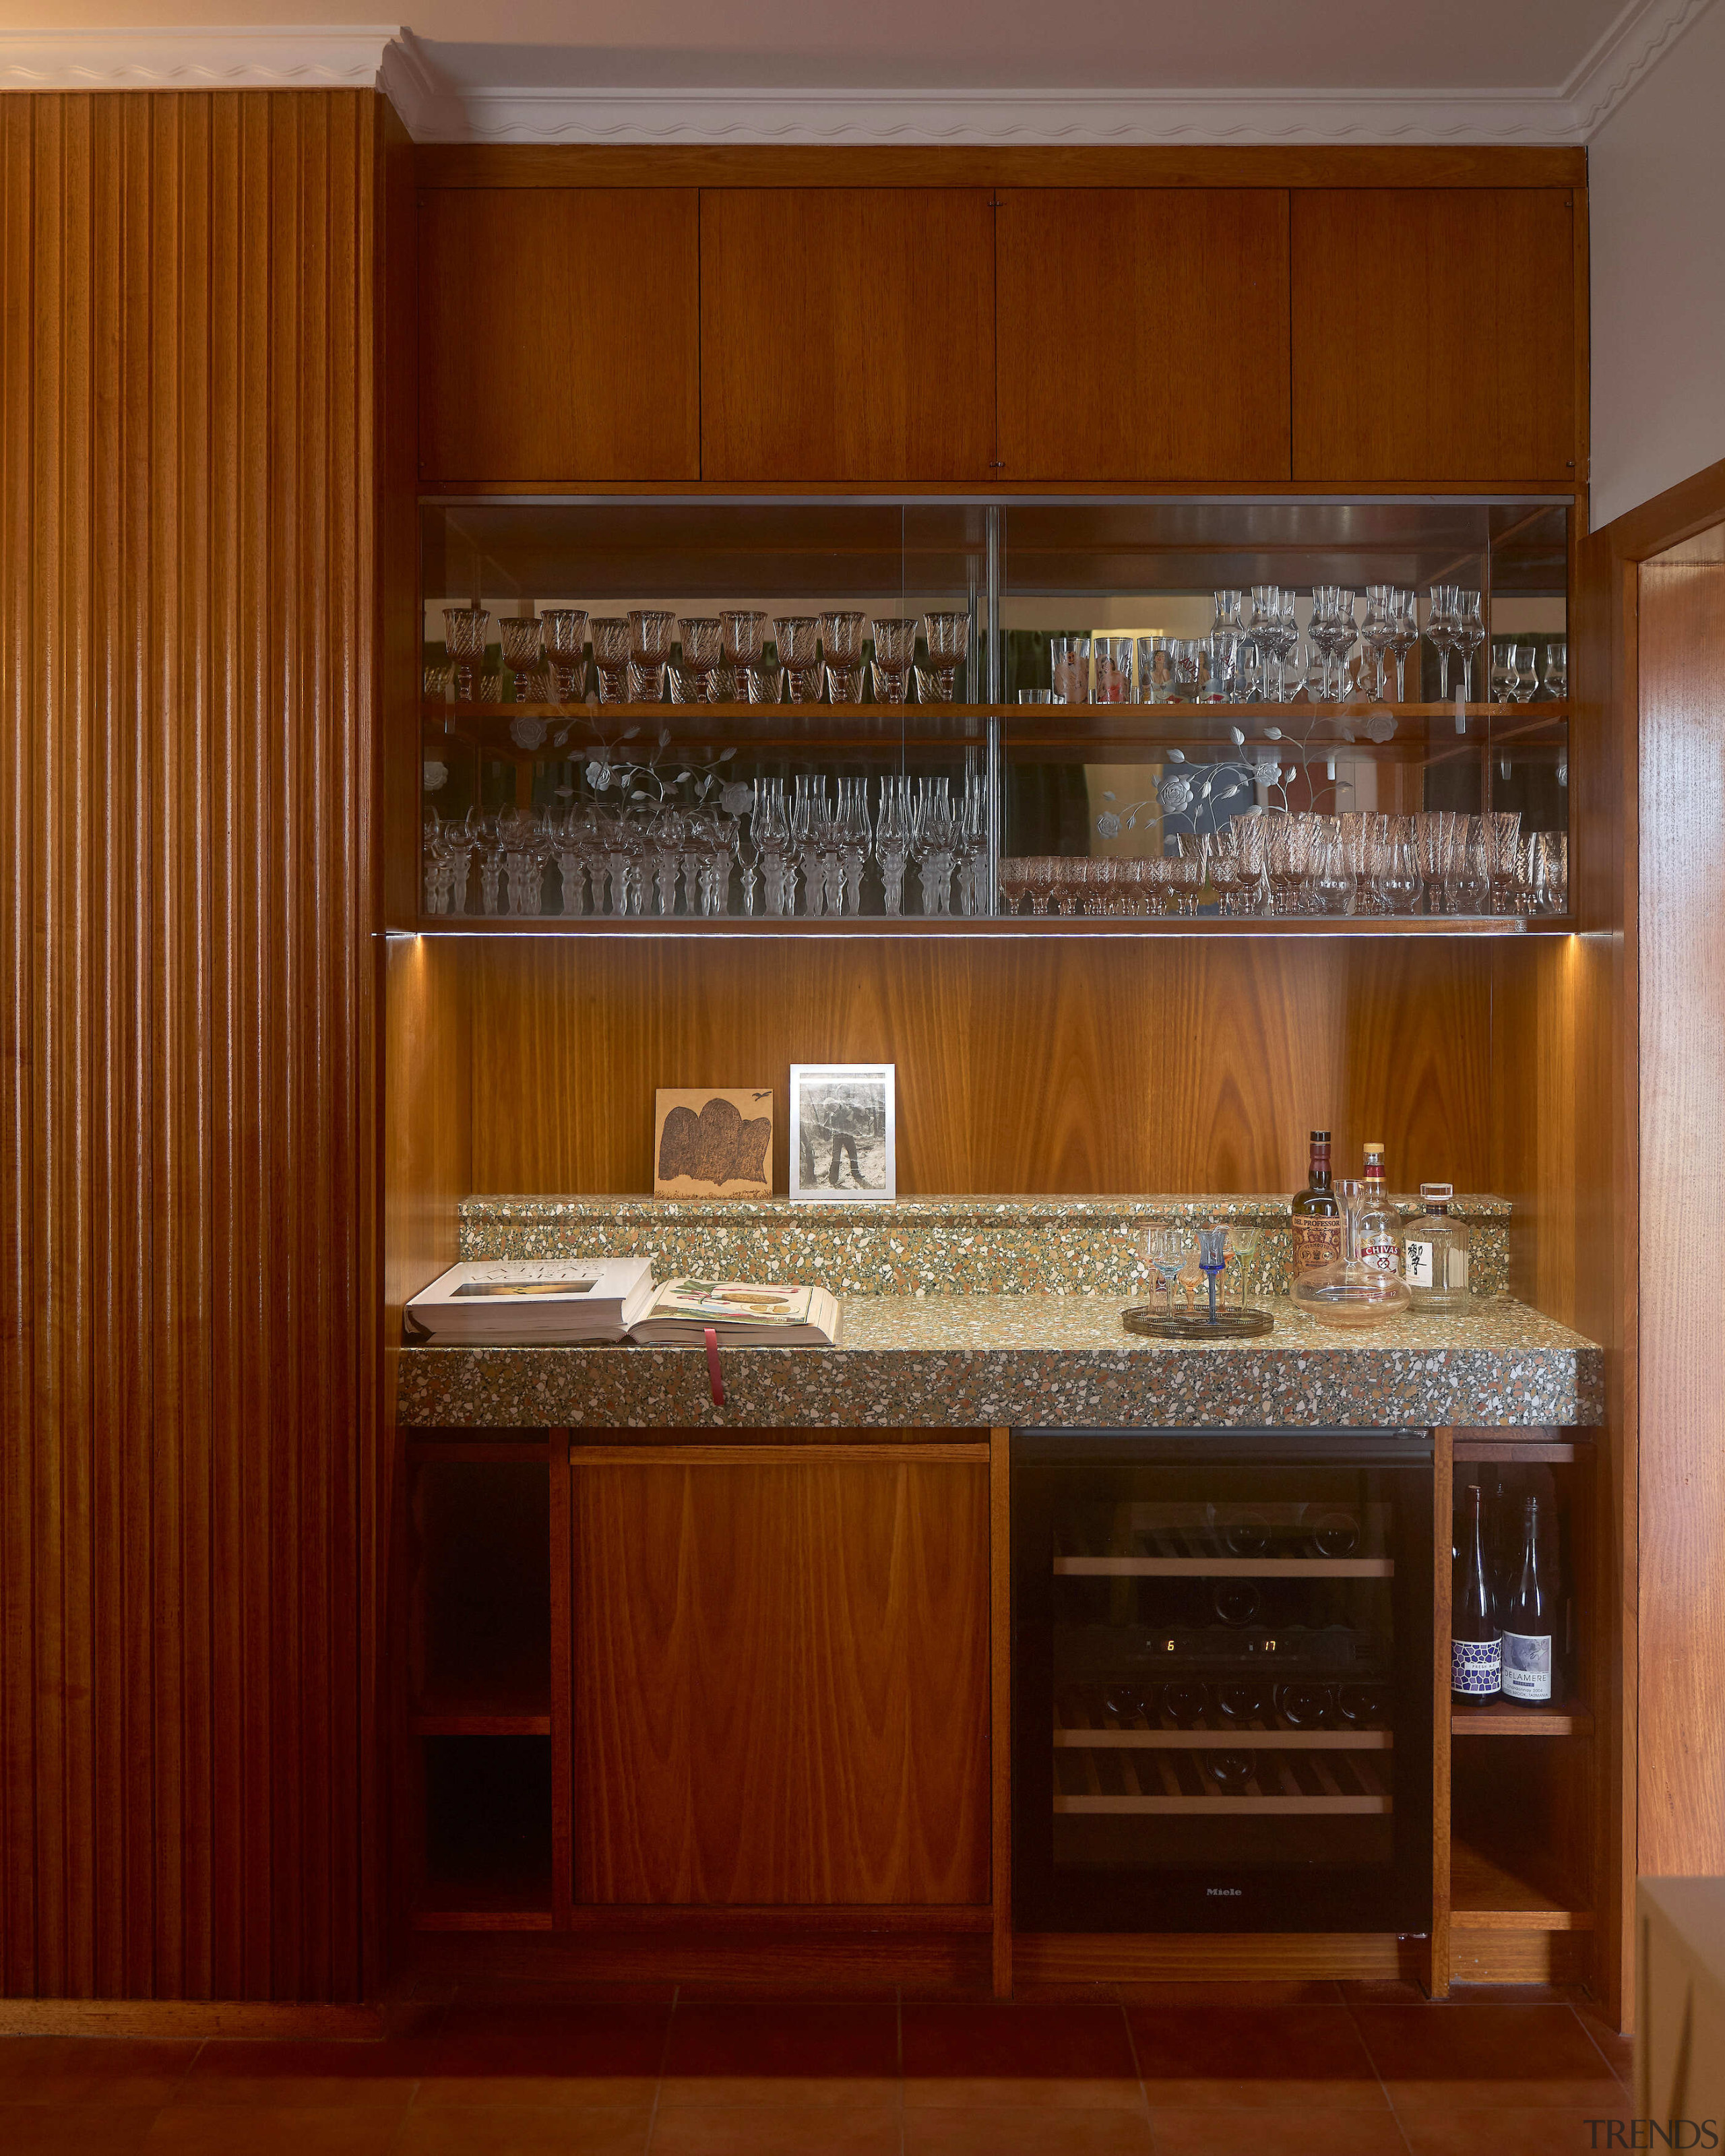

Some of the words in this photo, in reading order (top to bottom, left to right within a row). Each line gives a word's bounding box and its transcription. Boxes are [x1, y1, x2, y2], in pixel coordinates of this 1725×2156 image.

[1365, 1246, 1398, 1255] CHIVAS
[487, 1265, 599, 1273] ATLAS
[471, 1273, 604, 1281] WORLD
[1167, 1640, 1174, 1651] 6
[1265, 1641, 1276, 1651] 17
[1505, 1670, 1546, 1682] DELAMERE
[1507, 1684, 1532, 1692] Chardonnay
[1206, 1888, 1243, 1896] Miele
